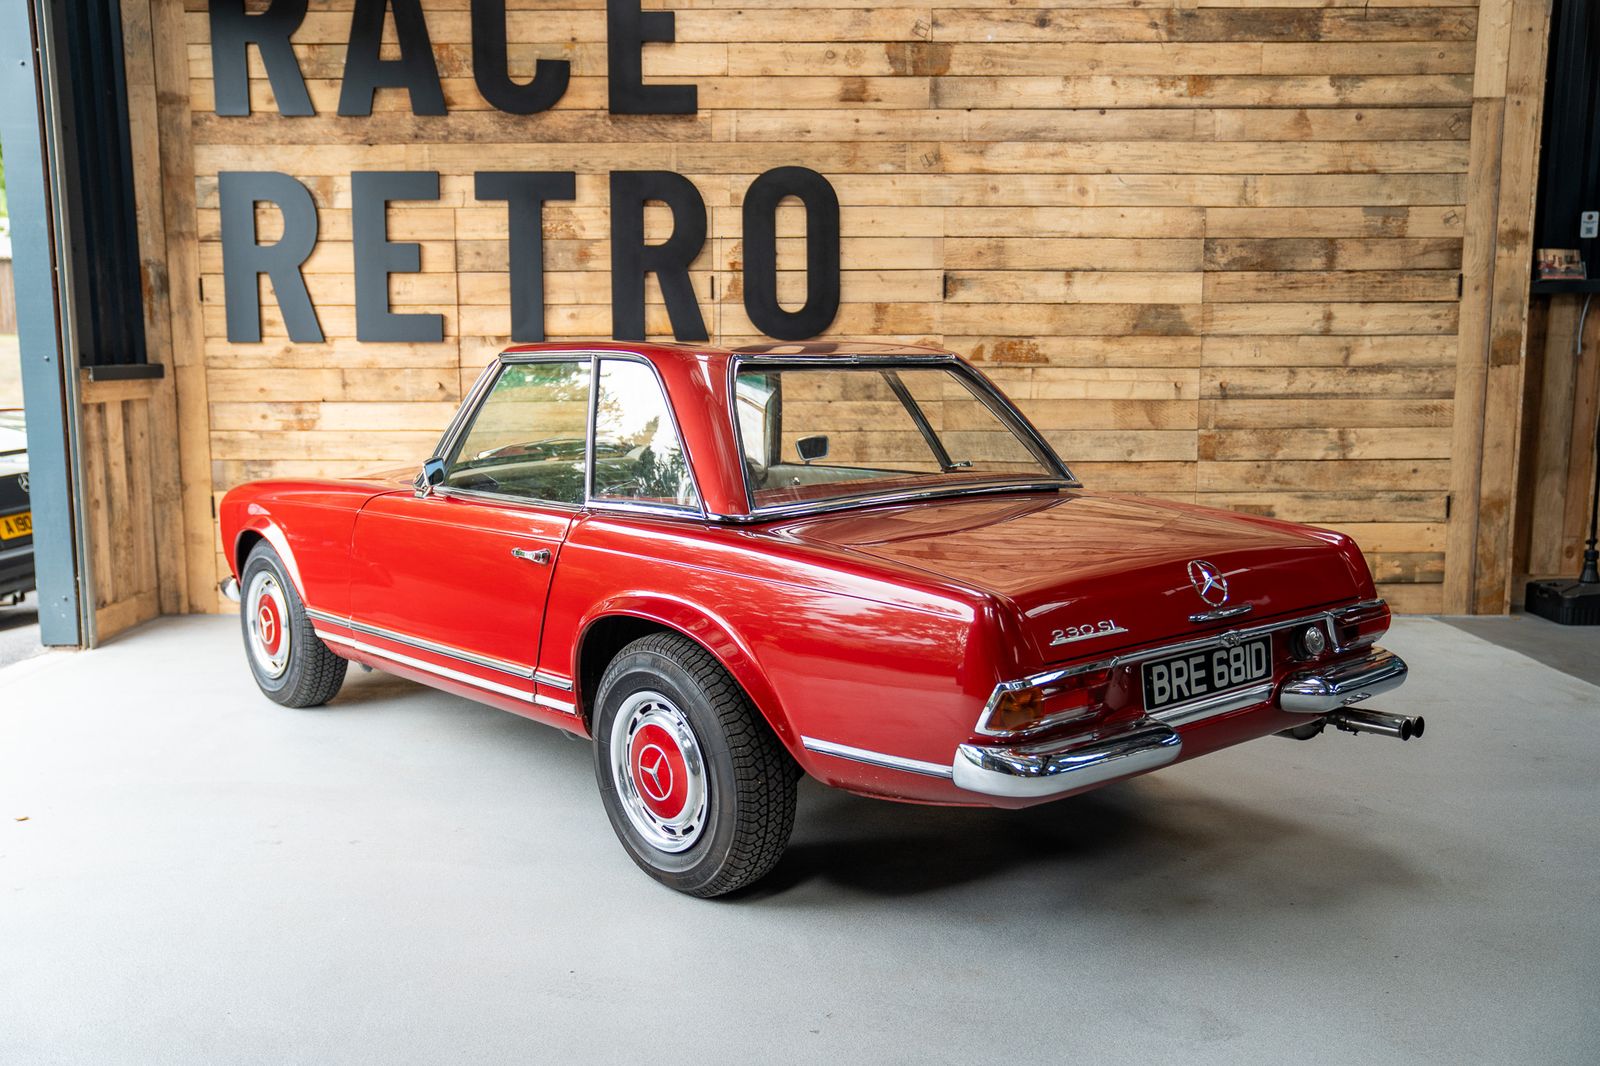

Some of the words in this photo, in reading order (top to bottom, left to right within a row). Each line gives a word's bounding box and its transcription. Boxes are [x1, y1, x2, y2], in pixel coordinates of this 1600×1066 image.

[209, 0, 698, 117] RACE
[217, 166, 840, 343] RETRO
[1052, 624, 1094, 641] 230
[1097, 619, 1124, 632] SL
[1152, 655, 1207, 705] BRE
[1212, 641, 1266, 688] 681D
